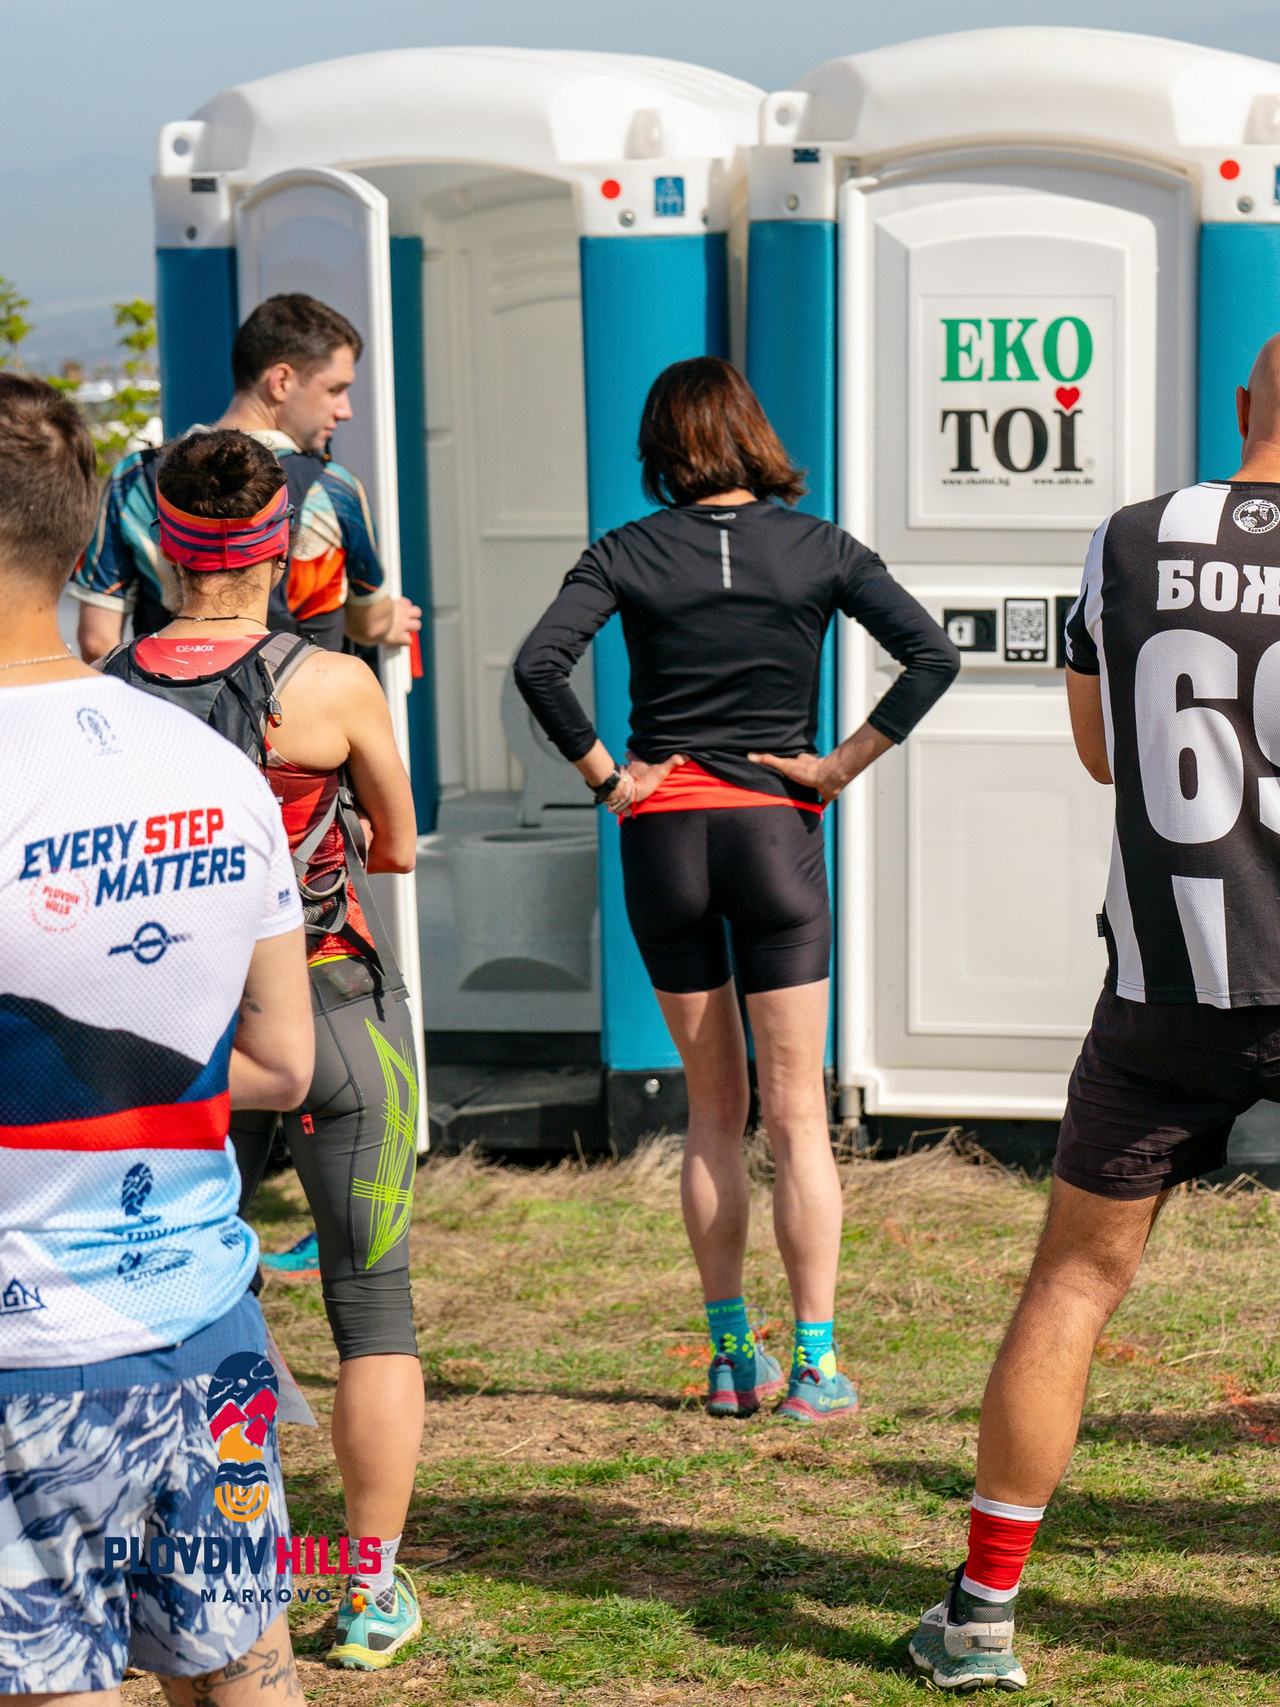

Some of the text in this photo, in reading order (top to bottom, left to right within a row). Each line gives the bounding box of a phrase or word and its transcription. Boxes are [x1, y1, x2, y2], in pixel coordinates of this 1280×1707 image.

[940, 316, 1093, 382] EKO
[940, 406, 1083, 473] TOI
[18, 807, 224, 881] EVERY STEP
[94, 845, 246, 907] MATTERS
